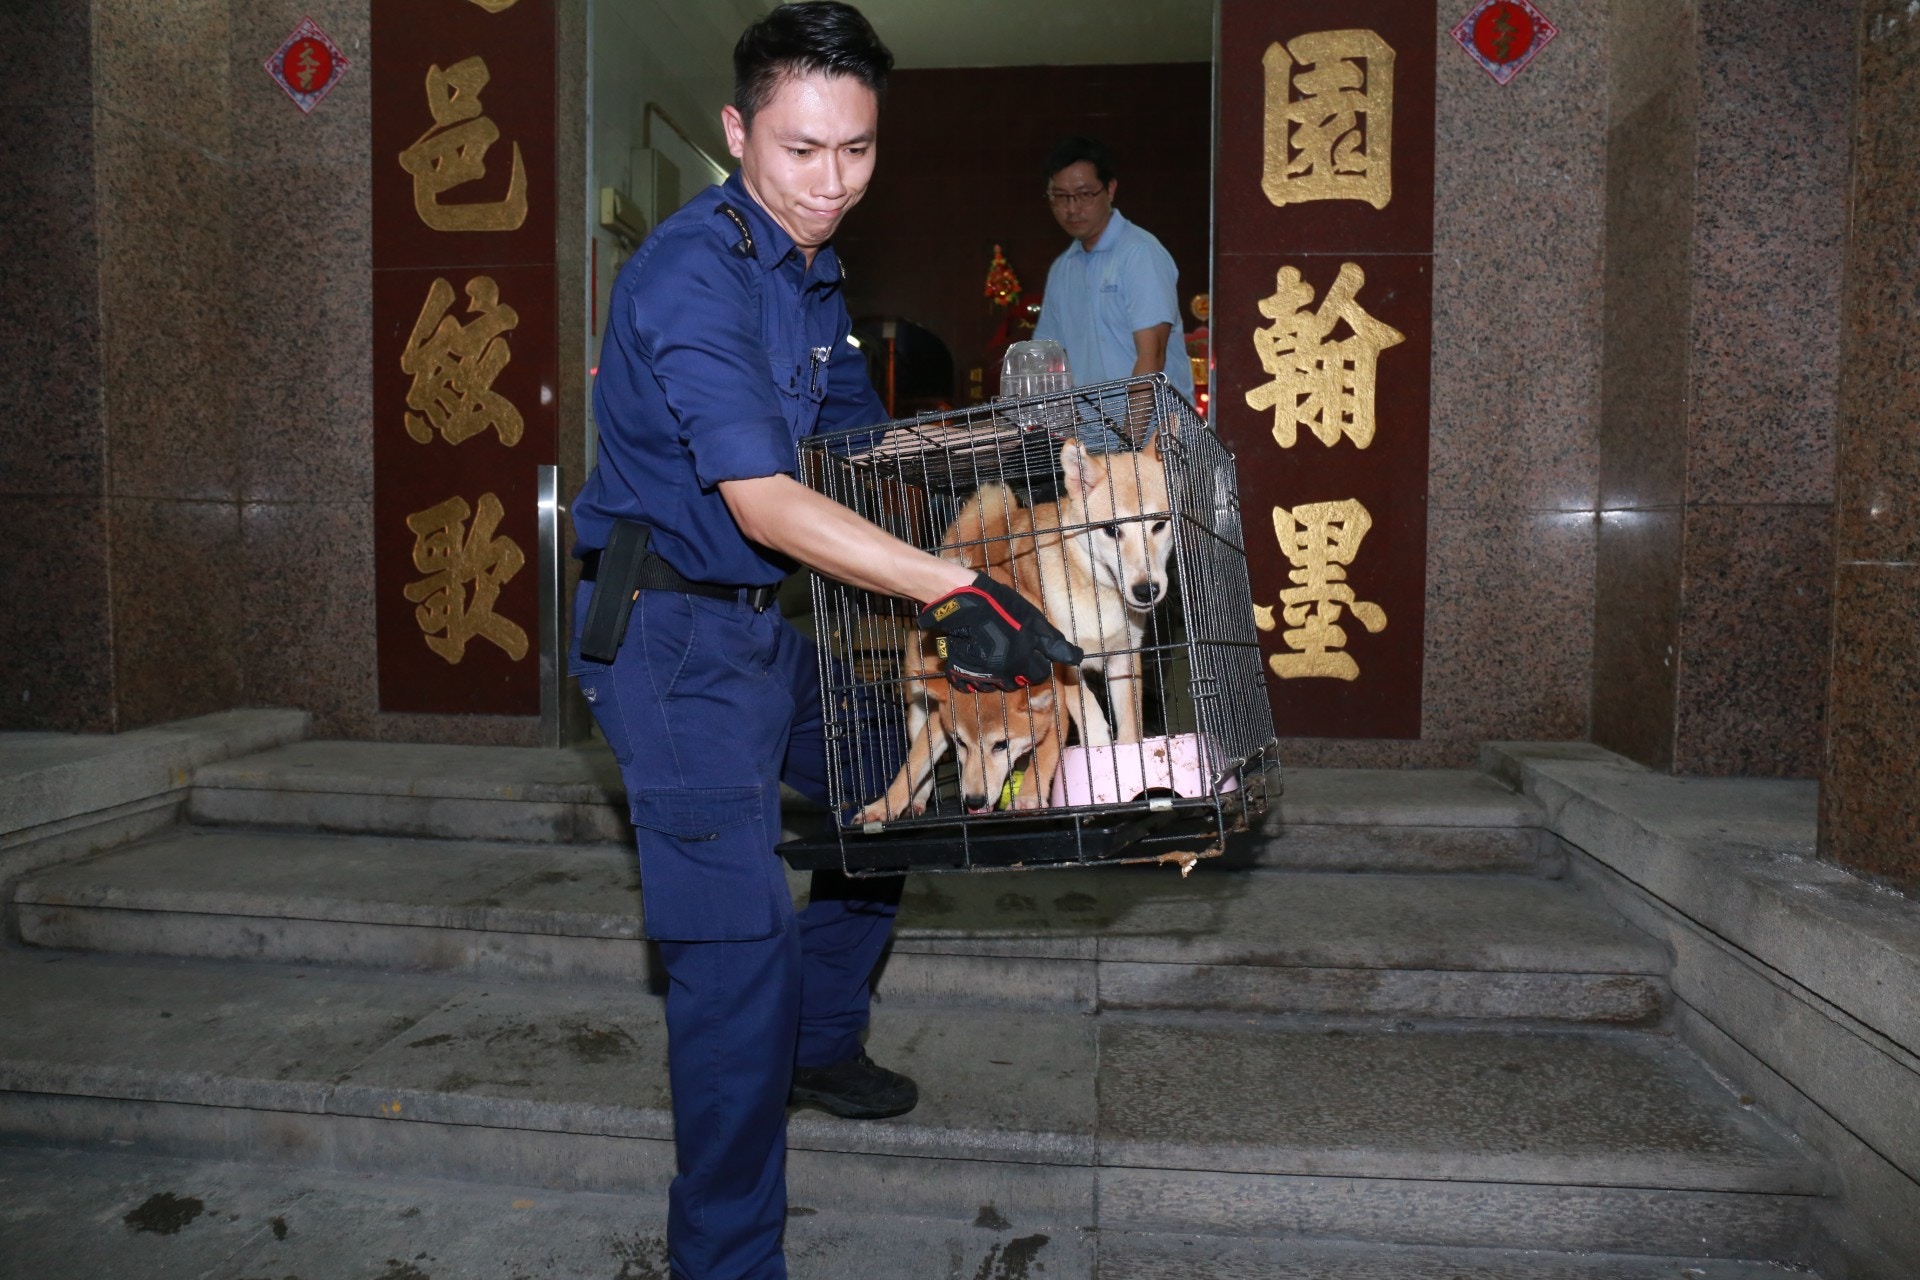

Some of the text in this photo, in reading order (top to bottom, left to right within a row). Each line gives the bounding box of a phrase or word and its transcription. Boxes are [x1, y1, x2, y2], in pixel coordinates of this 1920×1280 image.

[399, 0, 529, 664] 邑絃歌
[1245, 28, 1406, 681] 園翰墨
